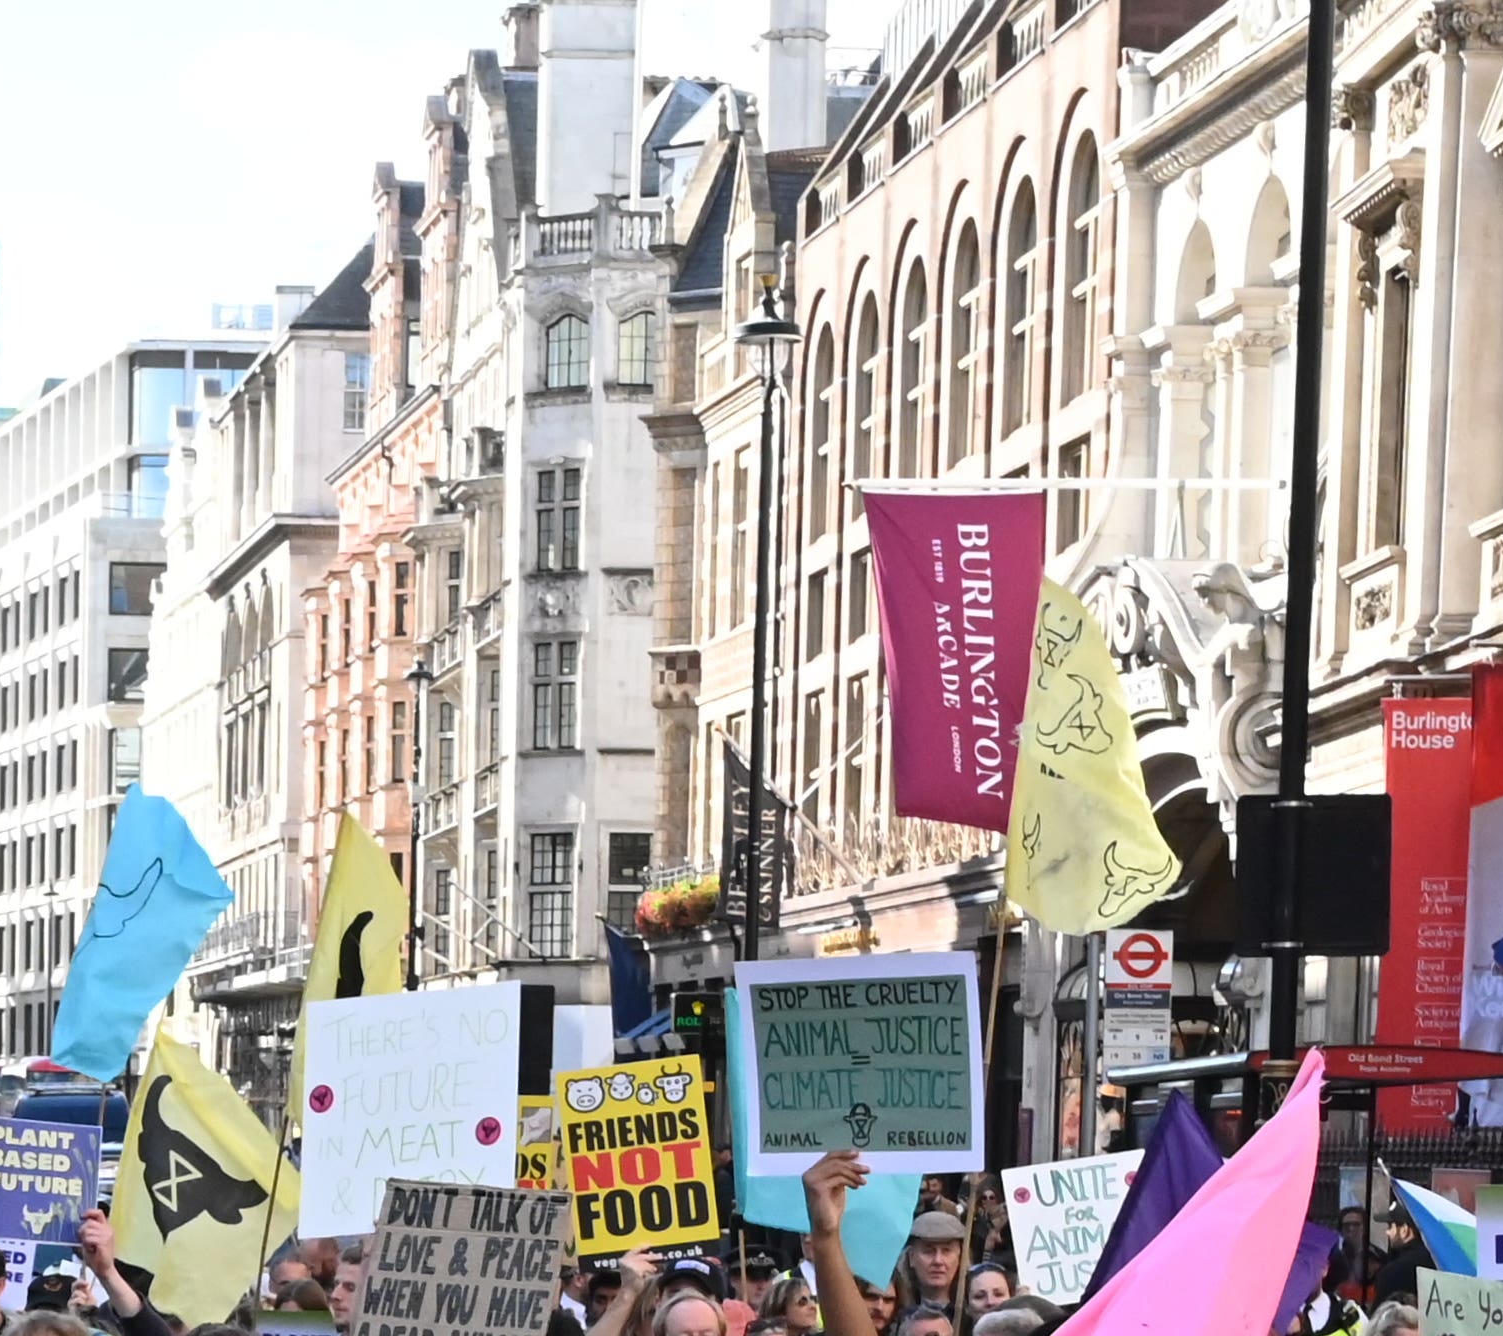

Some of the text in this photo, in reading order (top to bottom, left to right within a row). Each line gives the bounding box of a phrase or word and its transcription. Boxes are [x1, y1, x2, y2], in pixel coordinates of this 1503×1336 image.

[933, 601, 961, 708] ARCADE
[957, 523, 1004, 799] BURLINGTON
[951, 726, 962, 773] LONDON
[1391, 730, 1455, 749] House
[759, 808, 777, 904] SKINNER
[1421, 880, 1448, 892] Royal
[1417, 938, 1453, 949] Society
[1417, 959, 1445, 971] Royal
[758, 981, 958, 1012] STOP THE CRUELTY
[325, 1009, 509, 1061] THERE'S NO
[763, 1015, 963, 1058] ANIMAL JUSTICE
[1348, 1053, 1366, 1063] Old
[1394, 1053, 1423, 1064] Street
[341, 1060, 478, 1124] FUTURE
[762, 1068, 965, 1111] CLIMATE JUSTICE
[1411, 1096, 1446, 1108] Society
[318, 1120, 466, 1169] IN MEAT
[567, 1108, 701, 1153] FRIENDS
[763, 1130, 967, 1147] ANIMAL REBELLION
[571, 1141, 702, 1192] NOT
[1032, 1162, 1119, 1207] UNITE
[386, 1186, 459, 1228] DON'T
[470, 1188, 526, 1234] TALK
[529, 1194, 568, 1236] OF
[577, 1180, 710, 1241] FOOD
[1064, 1205, 1099, 1226] FOR
[378, 1231, 560, 1282] LOVE & PEACE
[1026, 1225, 1105, 1263] ANIM
[362, 1275, 550, 1330] WHEN YOU HAVE
[1425, 1279, 1465, 1321] Are
